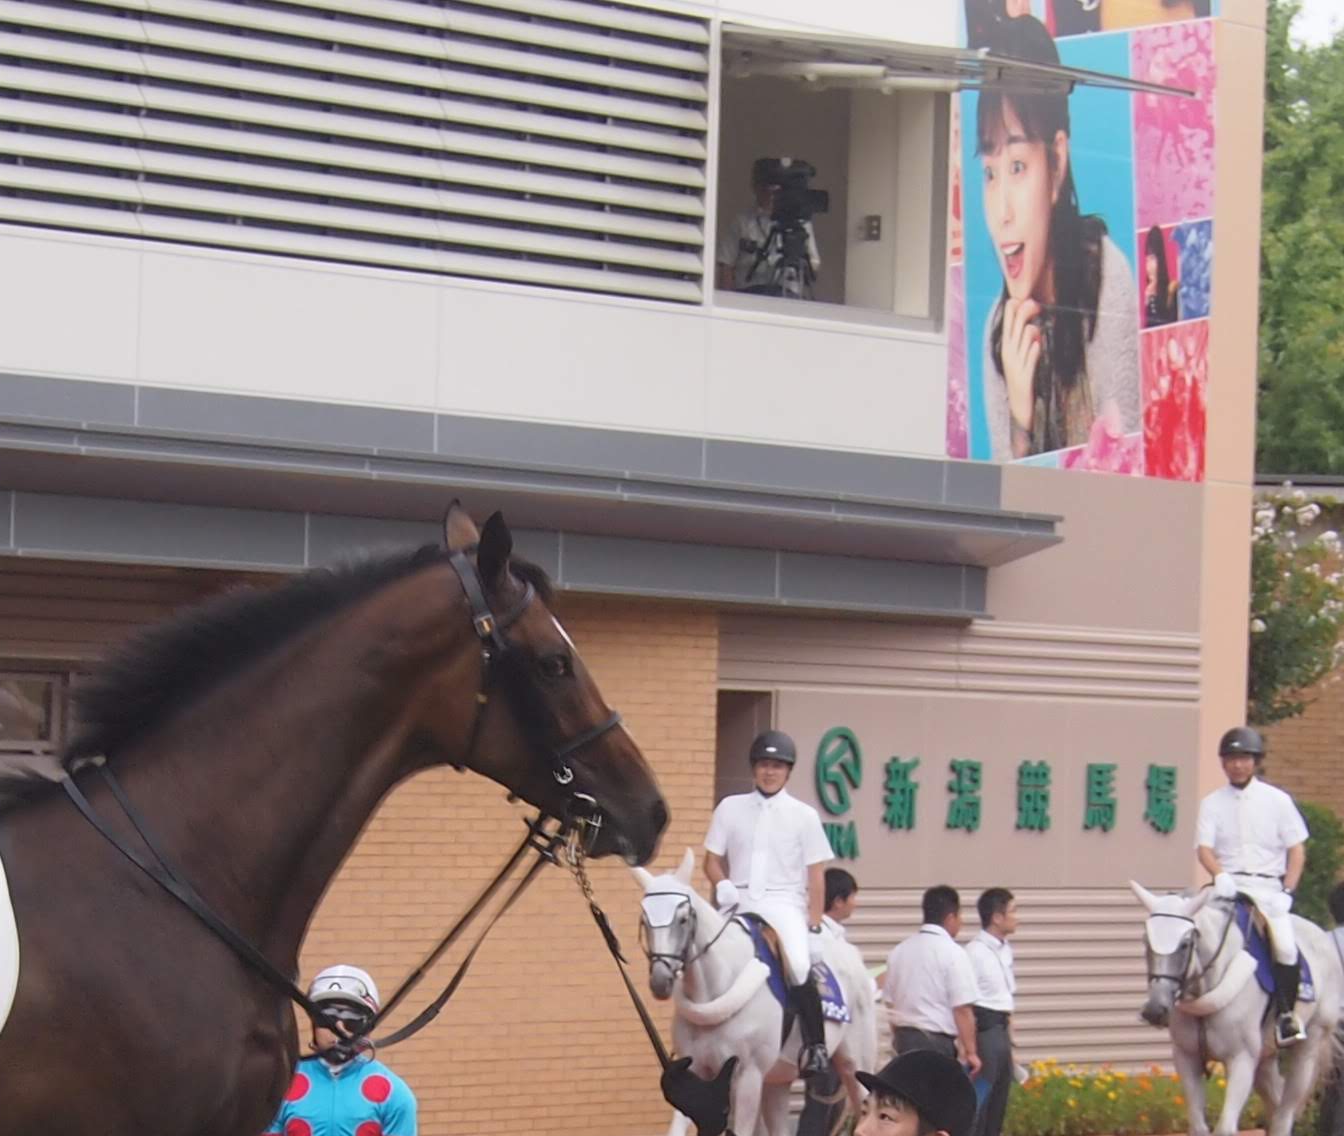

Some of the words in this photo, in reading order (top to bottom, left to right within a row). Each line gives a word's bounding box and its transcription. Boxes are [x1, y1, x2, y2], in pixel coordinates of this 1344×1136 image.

[881, 756, 1177, 834] 新潟競馬場
